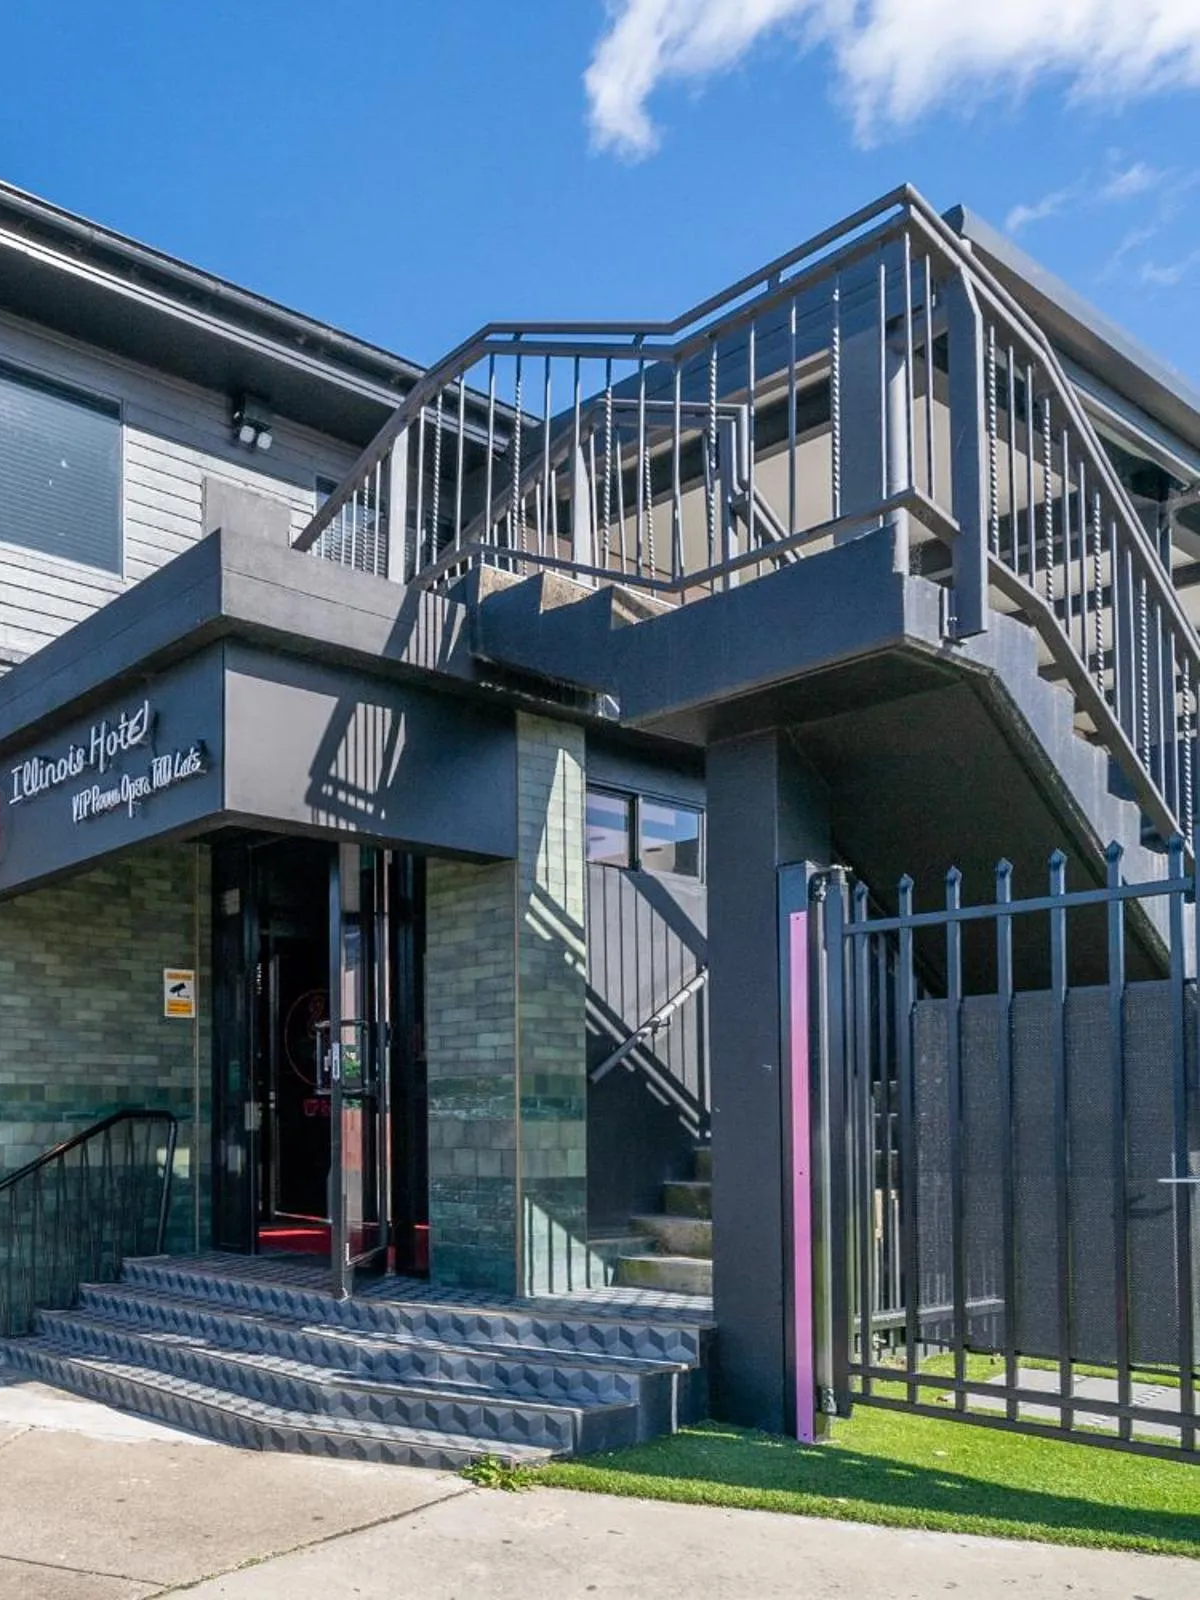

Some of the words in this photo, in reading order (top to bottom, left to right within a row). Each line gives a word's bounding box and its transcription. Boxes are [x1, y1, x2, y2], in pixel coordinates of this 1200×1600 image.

[8, 744, 85, 805] Illinois
[89, 700, 149, 774] Hotel
[72, 789, 92, 823] VIP
[91, 784, 121, 815] Room
